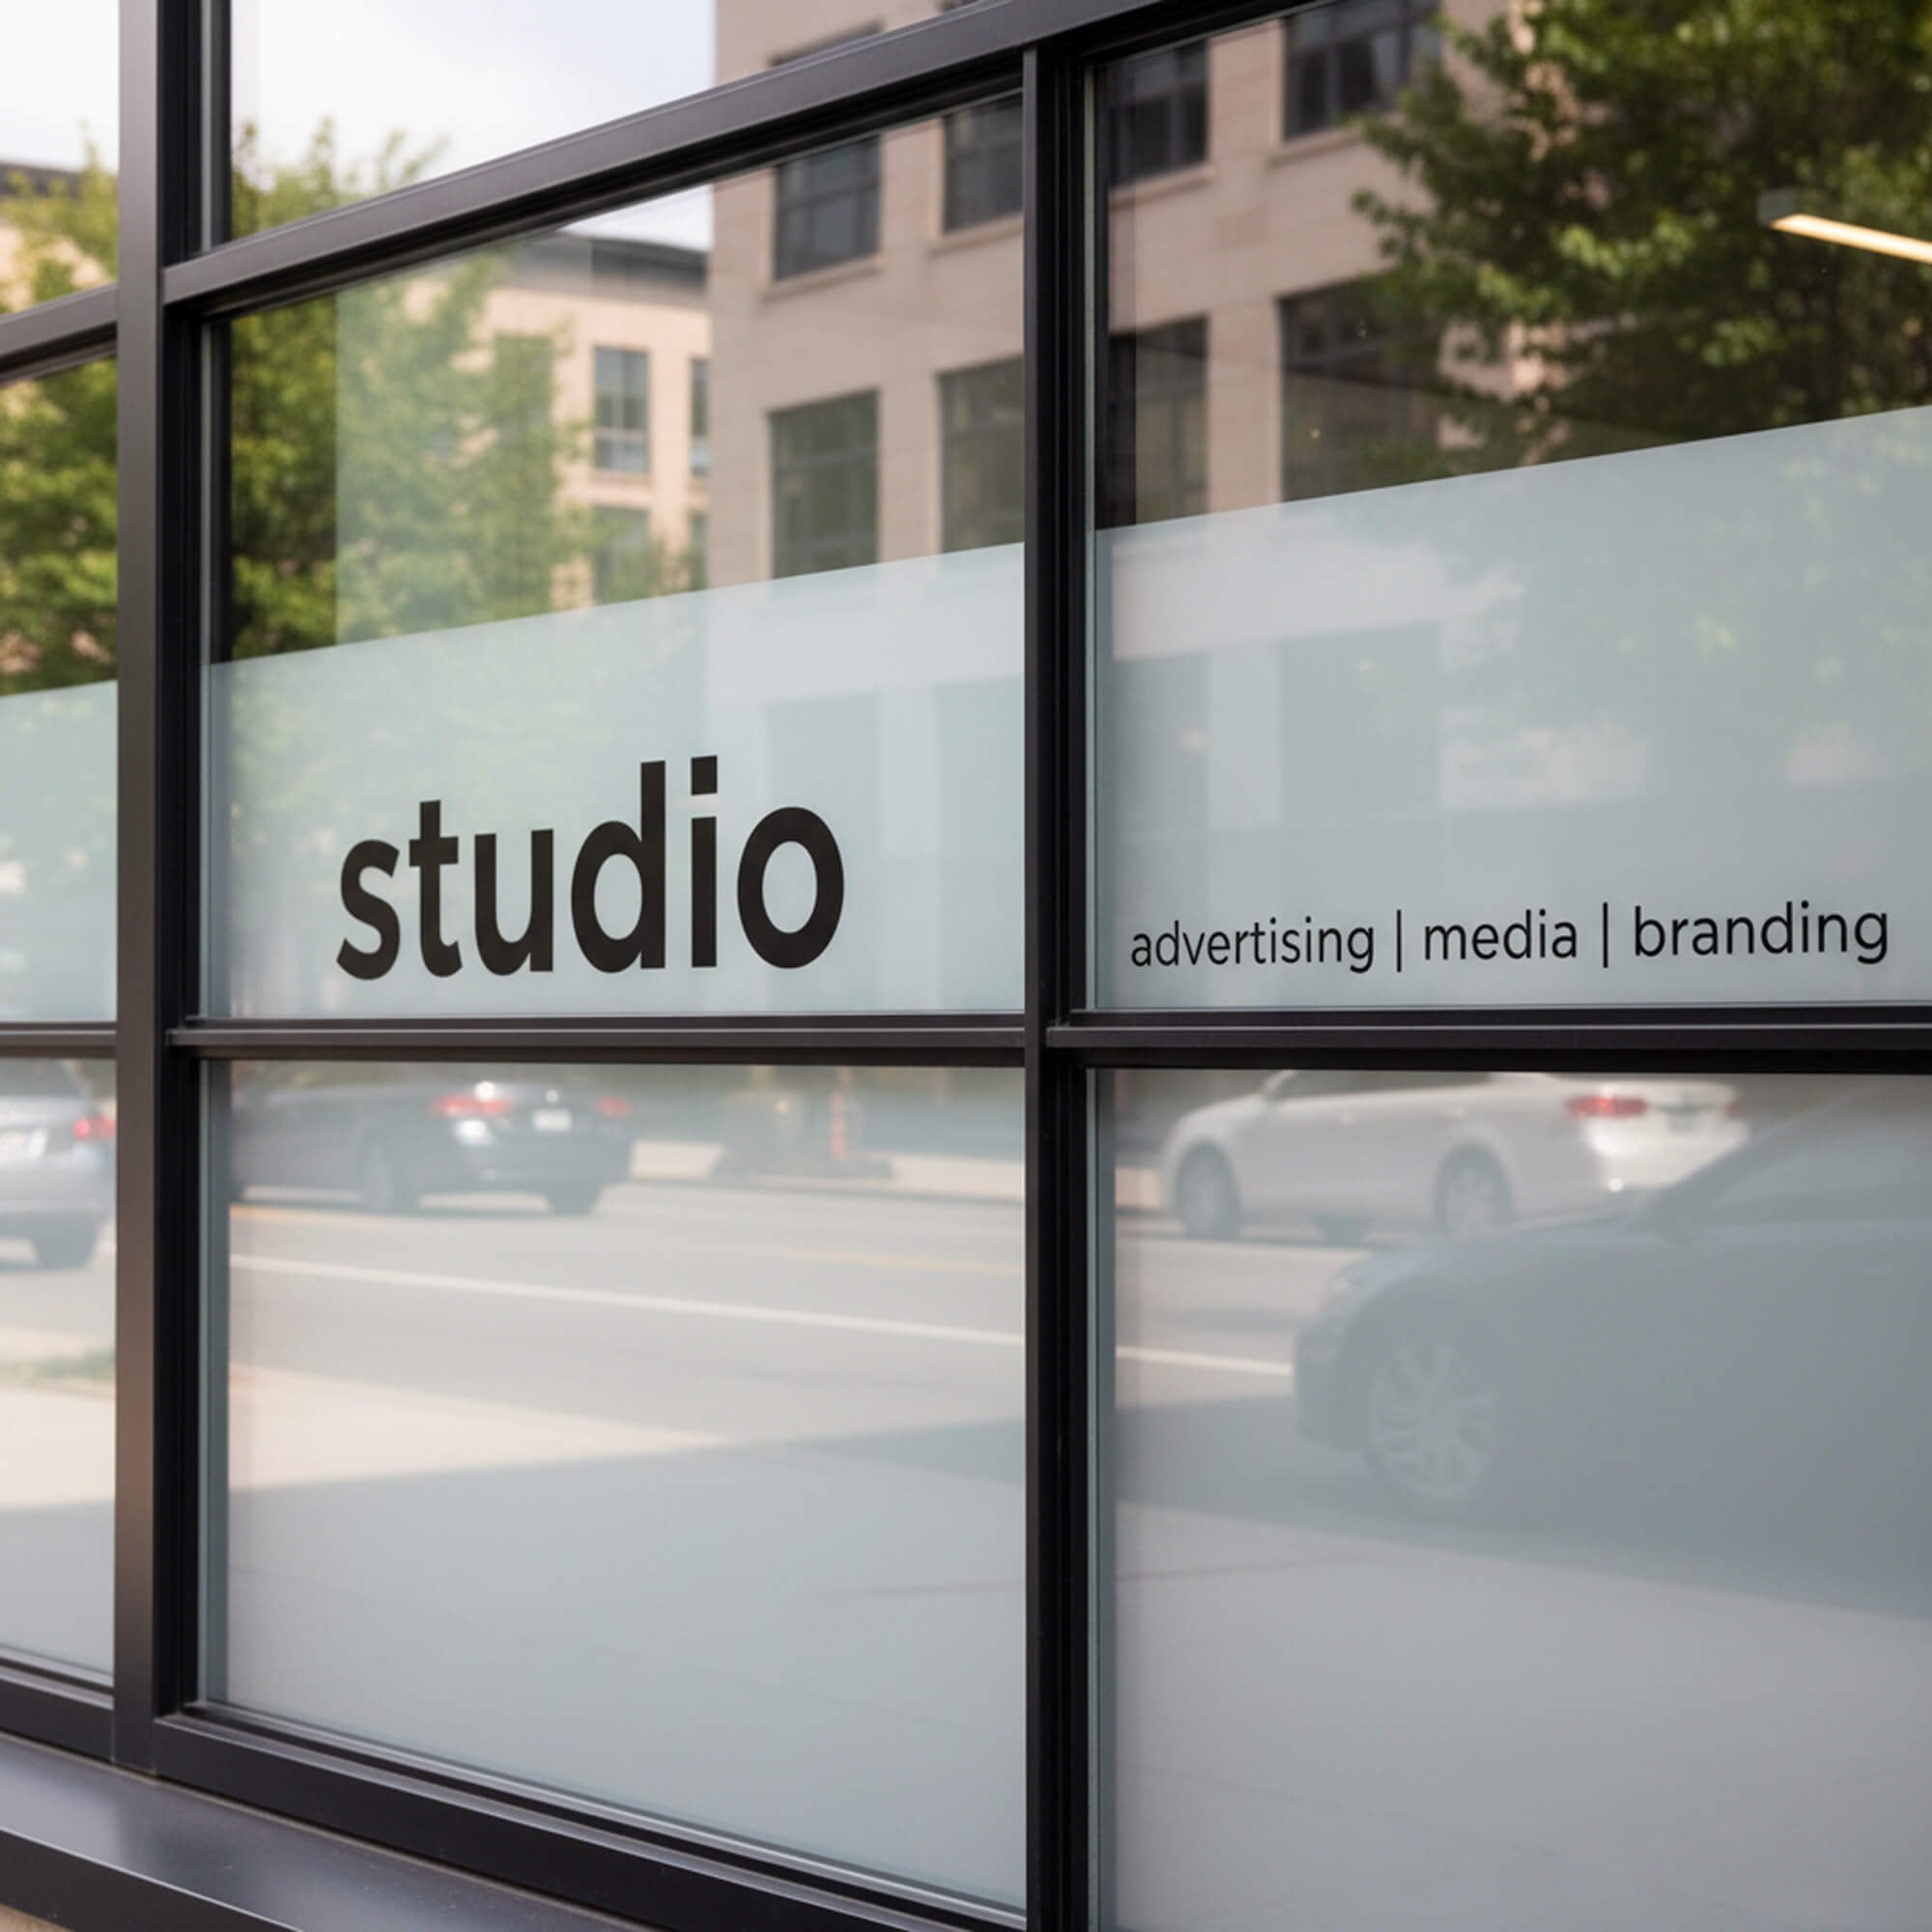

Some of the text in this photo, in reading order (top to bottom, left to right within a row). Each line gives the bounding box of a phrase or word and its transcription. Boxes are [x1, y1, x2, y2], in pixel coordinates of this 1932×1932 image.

[337, 755, 844, 980] studio
[1130, 917, 1375, 974] advertising
[1425, 908, 1577, 961] media
[1634, 899, 1889, 966] branding
